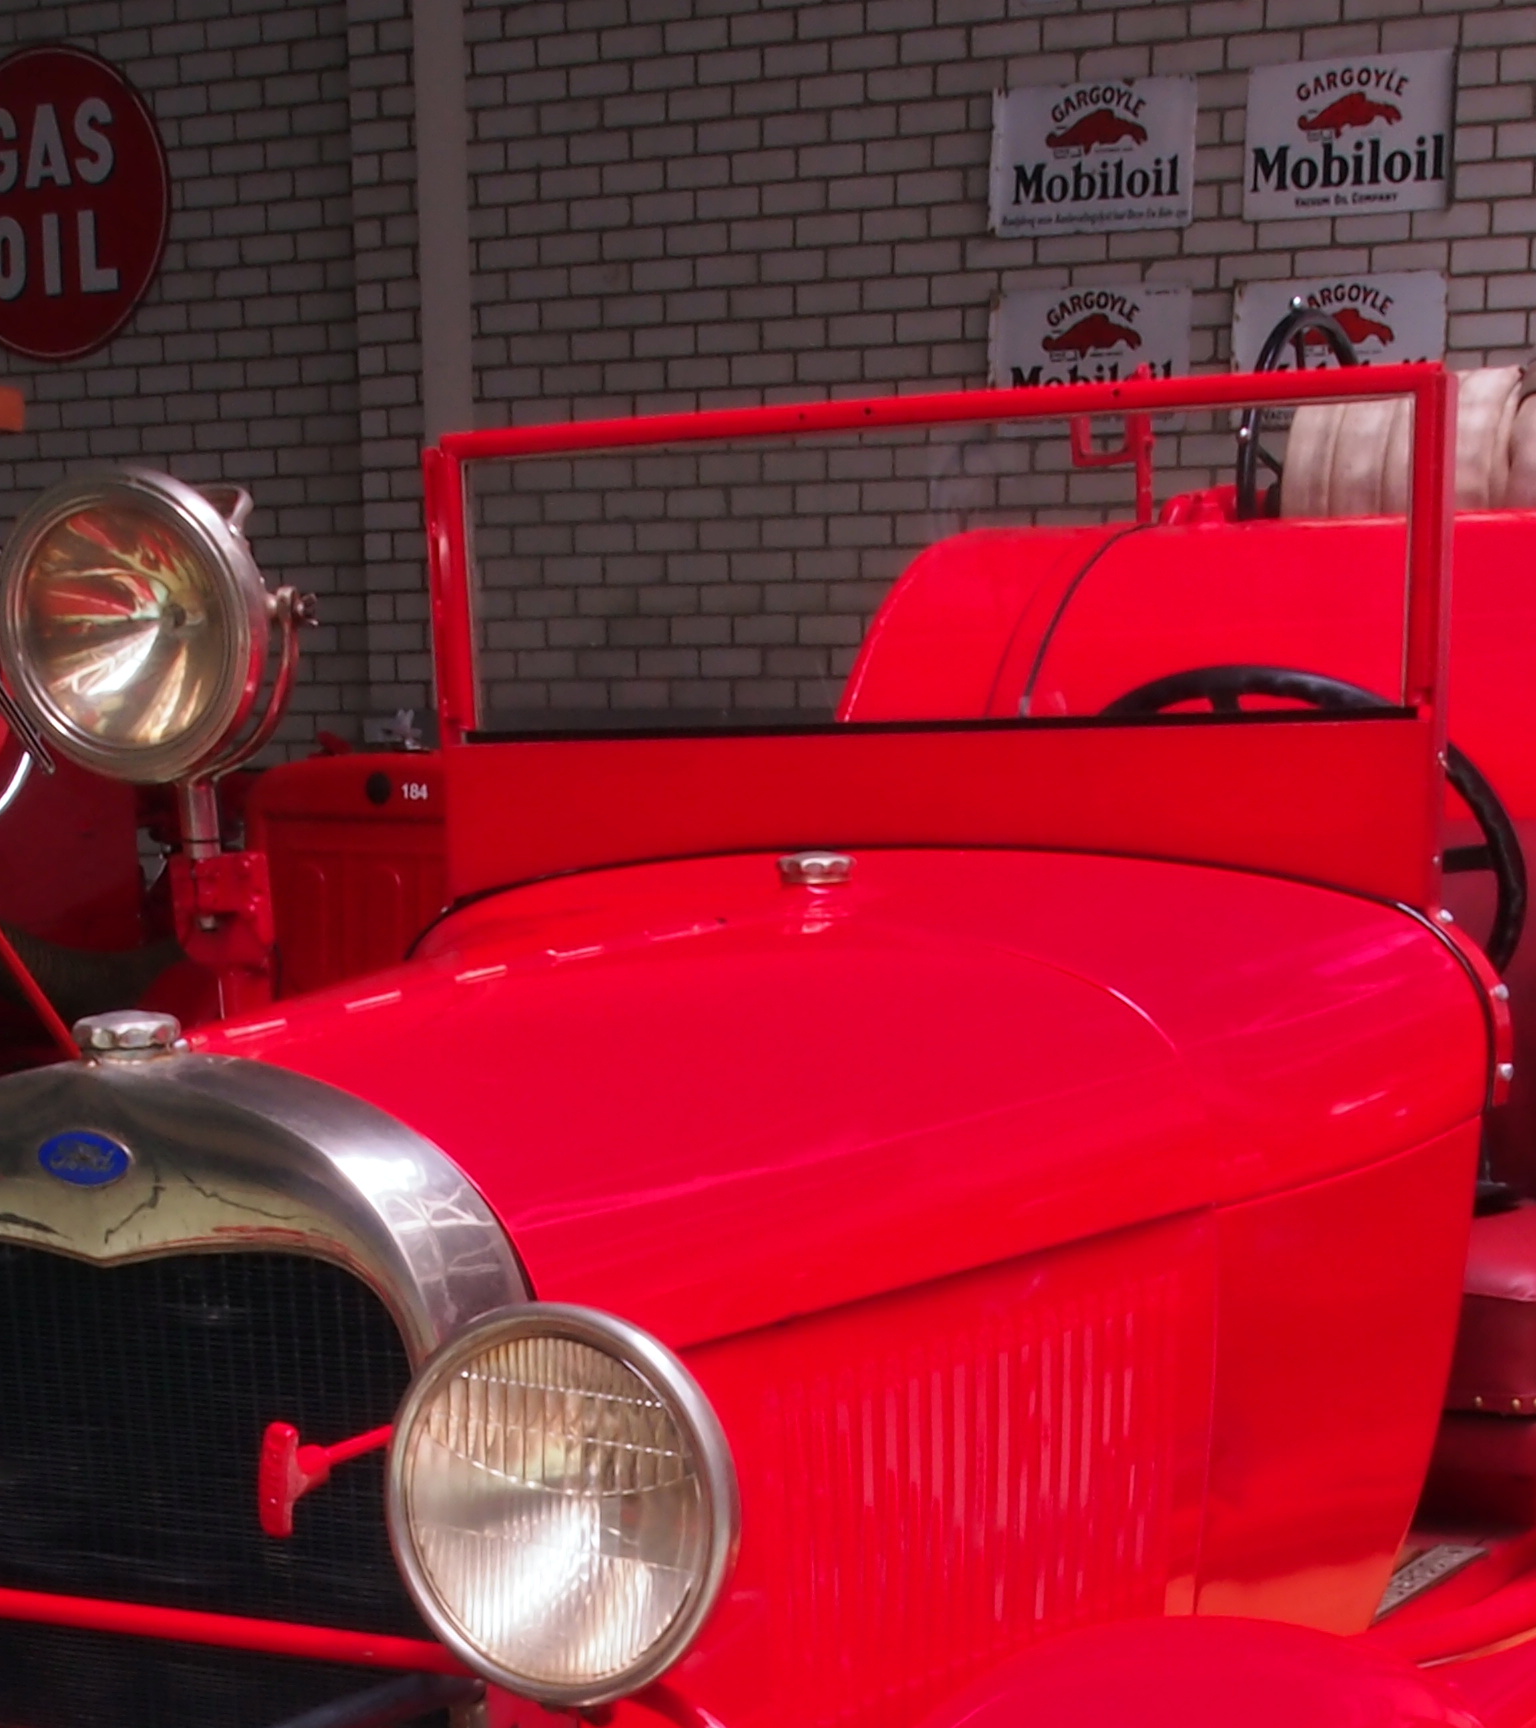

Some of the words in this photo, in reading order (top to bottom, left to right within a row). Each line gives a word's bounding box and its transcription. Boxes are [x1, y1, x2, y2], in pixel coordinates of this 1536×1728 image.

[1296, 66, 1410, 102] GARGOYLE
[1051, 84, 1147, 124] GARGOYLE
[1012, 154, 1180, 206] Mobiloil
[1249, 134, 1445, 193] Mobiloil
[1046, 290, 1142, 327] GARGOYLE
[1306, 283, 1395, 316] ARGOYLE
[400, 782, 429, 800] 184
[49, 1141, 116, 1173] Ford
